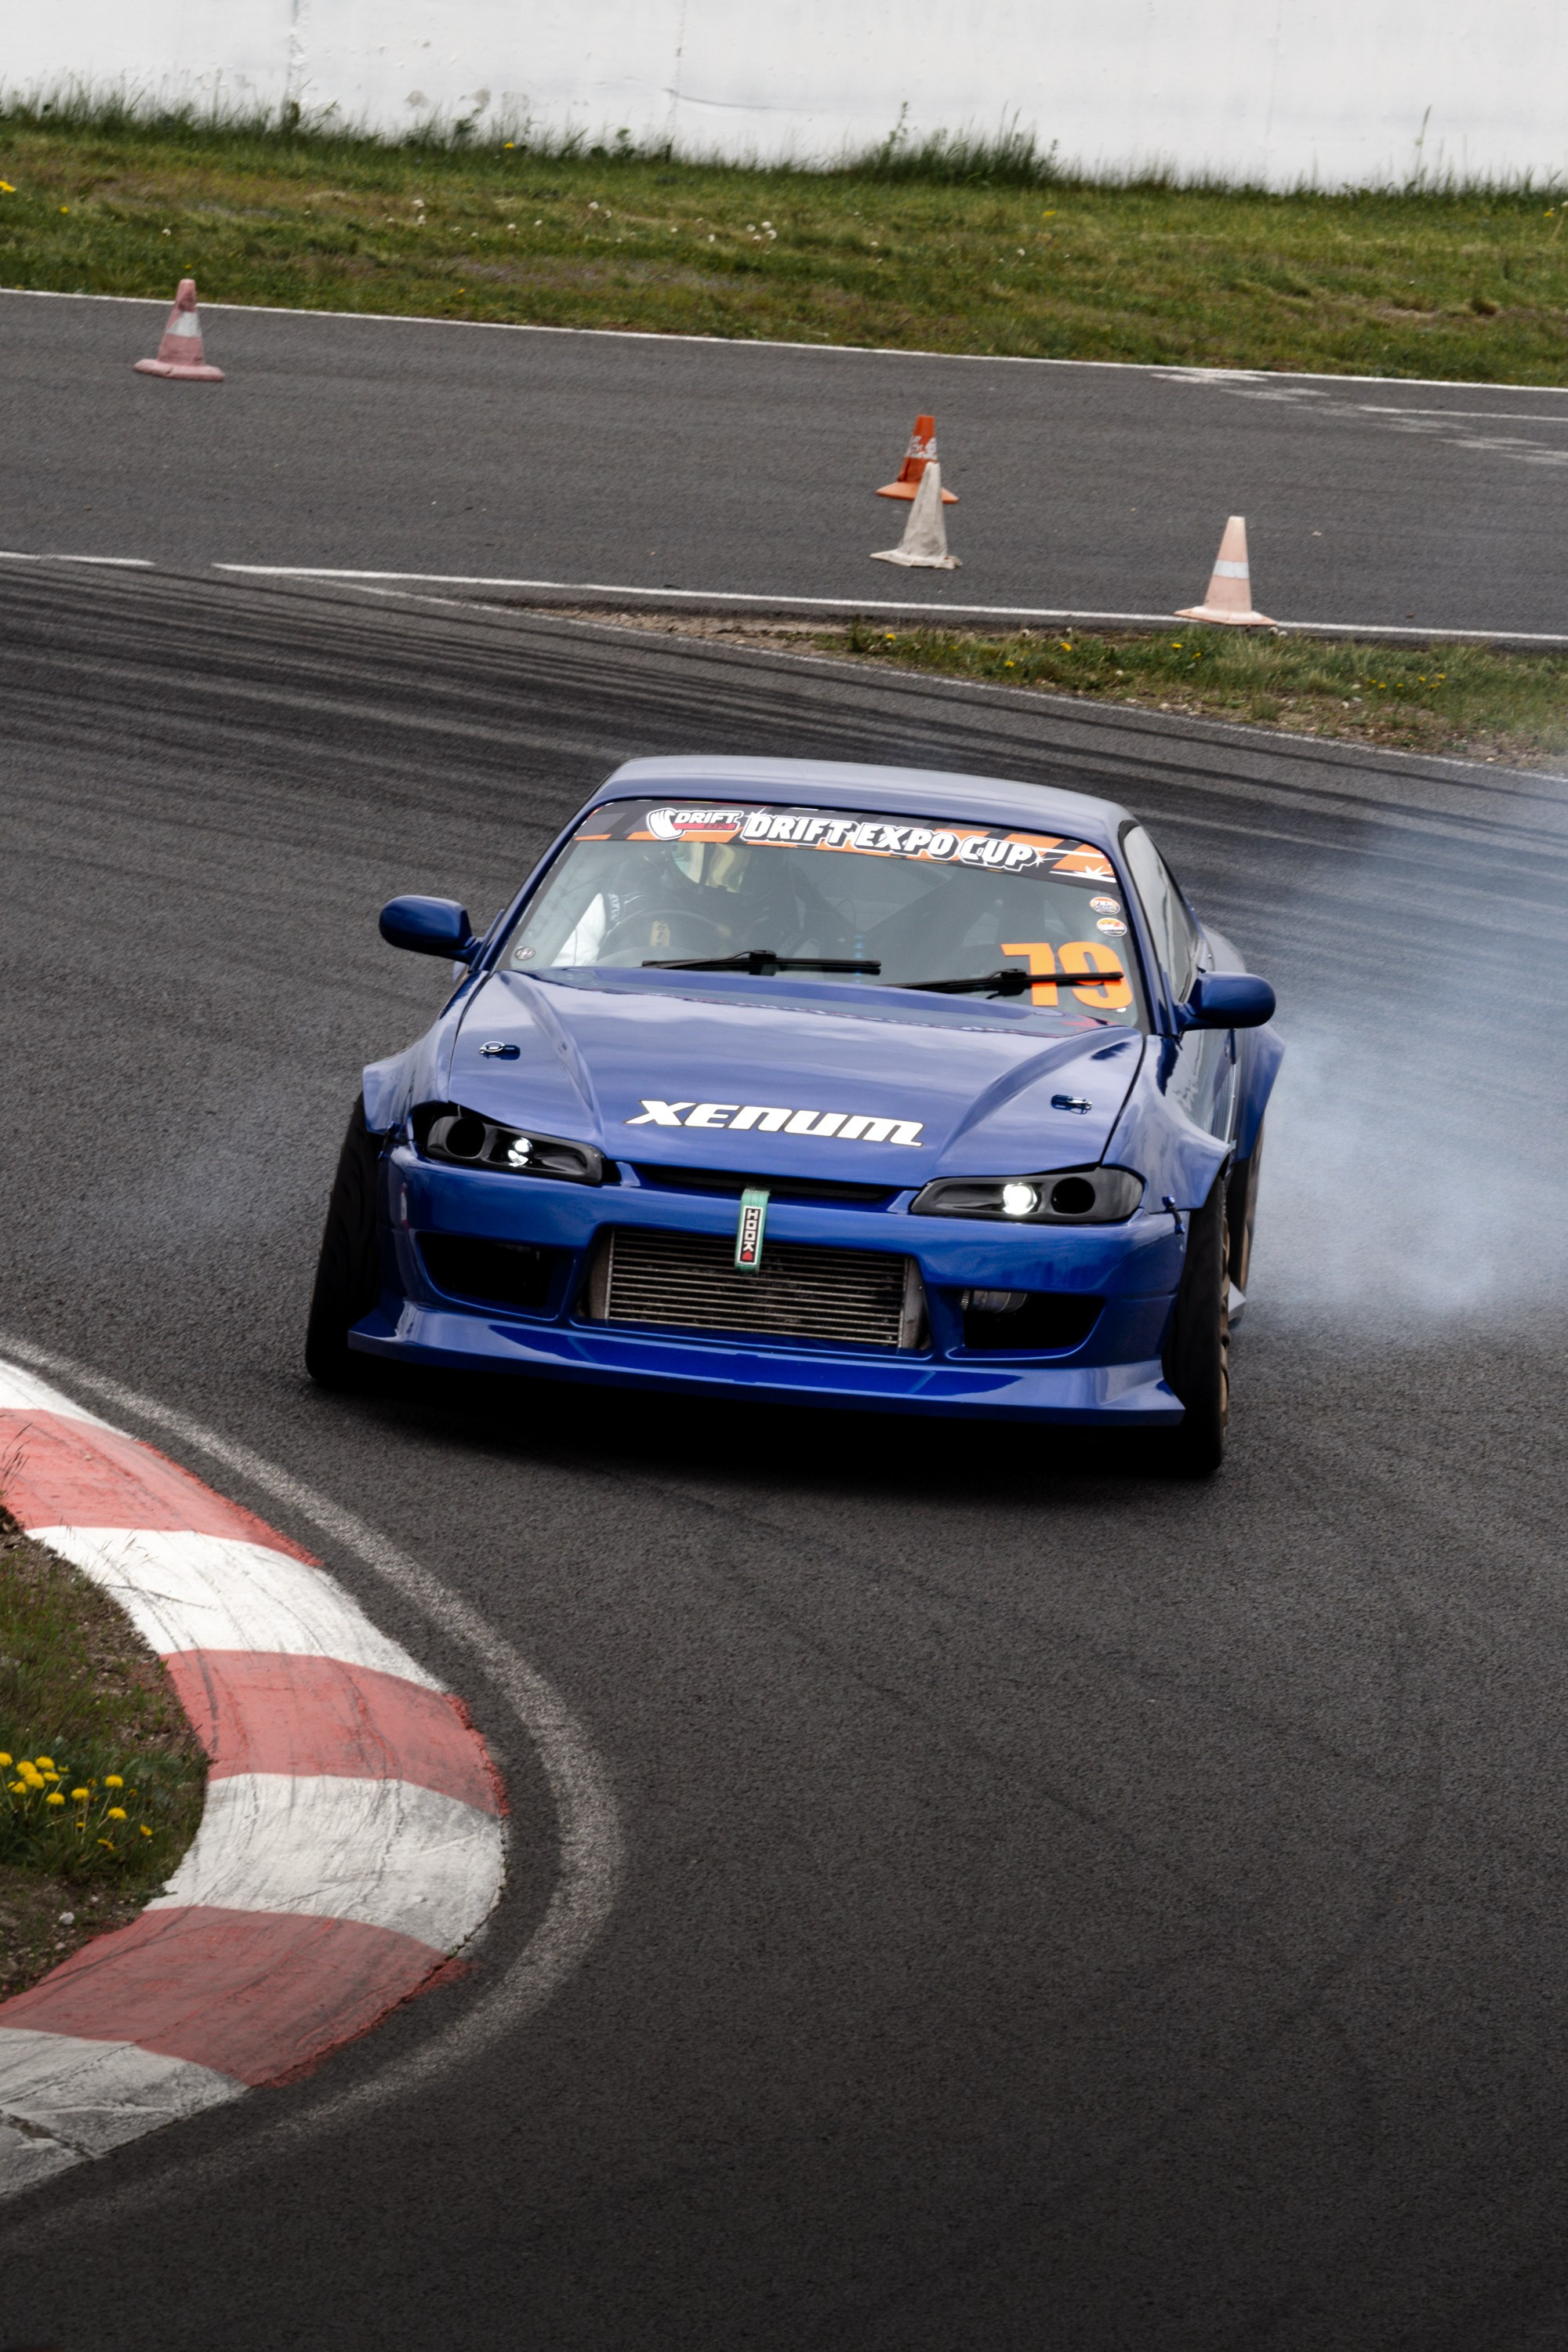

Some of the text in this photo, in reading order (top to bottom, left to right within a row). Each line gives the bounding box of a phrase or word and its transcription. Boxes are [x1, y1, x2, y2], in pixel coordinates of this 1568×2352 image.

[674, 811, 740, 824] DRIFT
[742, 815, 1034, 867] DRIFT EXPO CUP
[1001, 942, 1133, 1008] 79
[625, 1100, 924, 1147] XENUM
